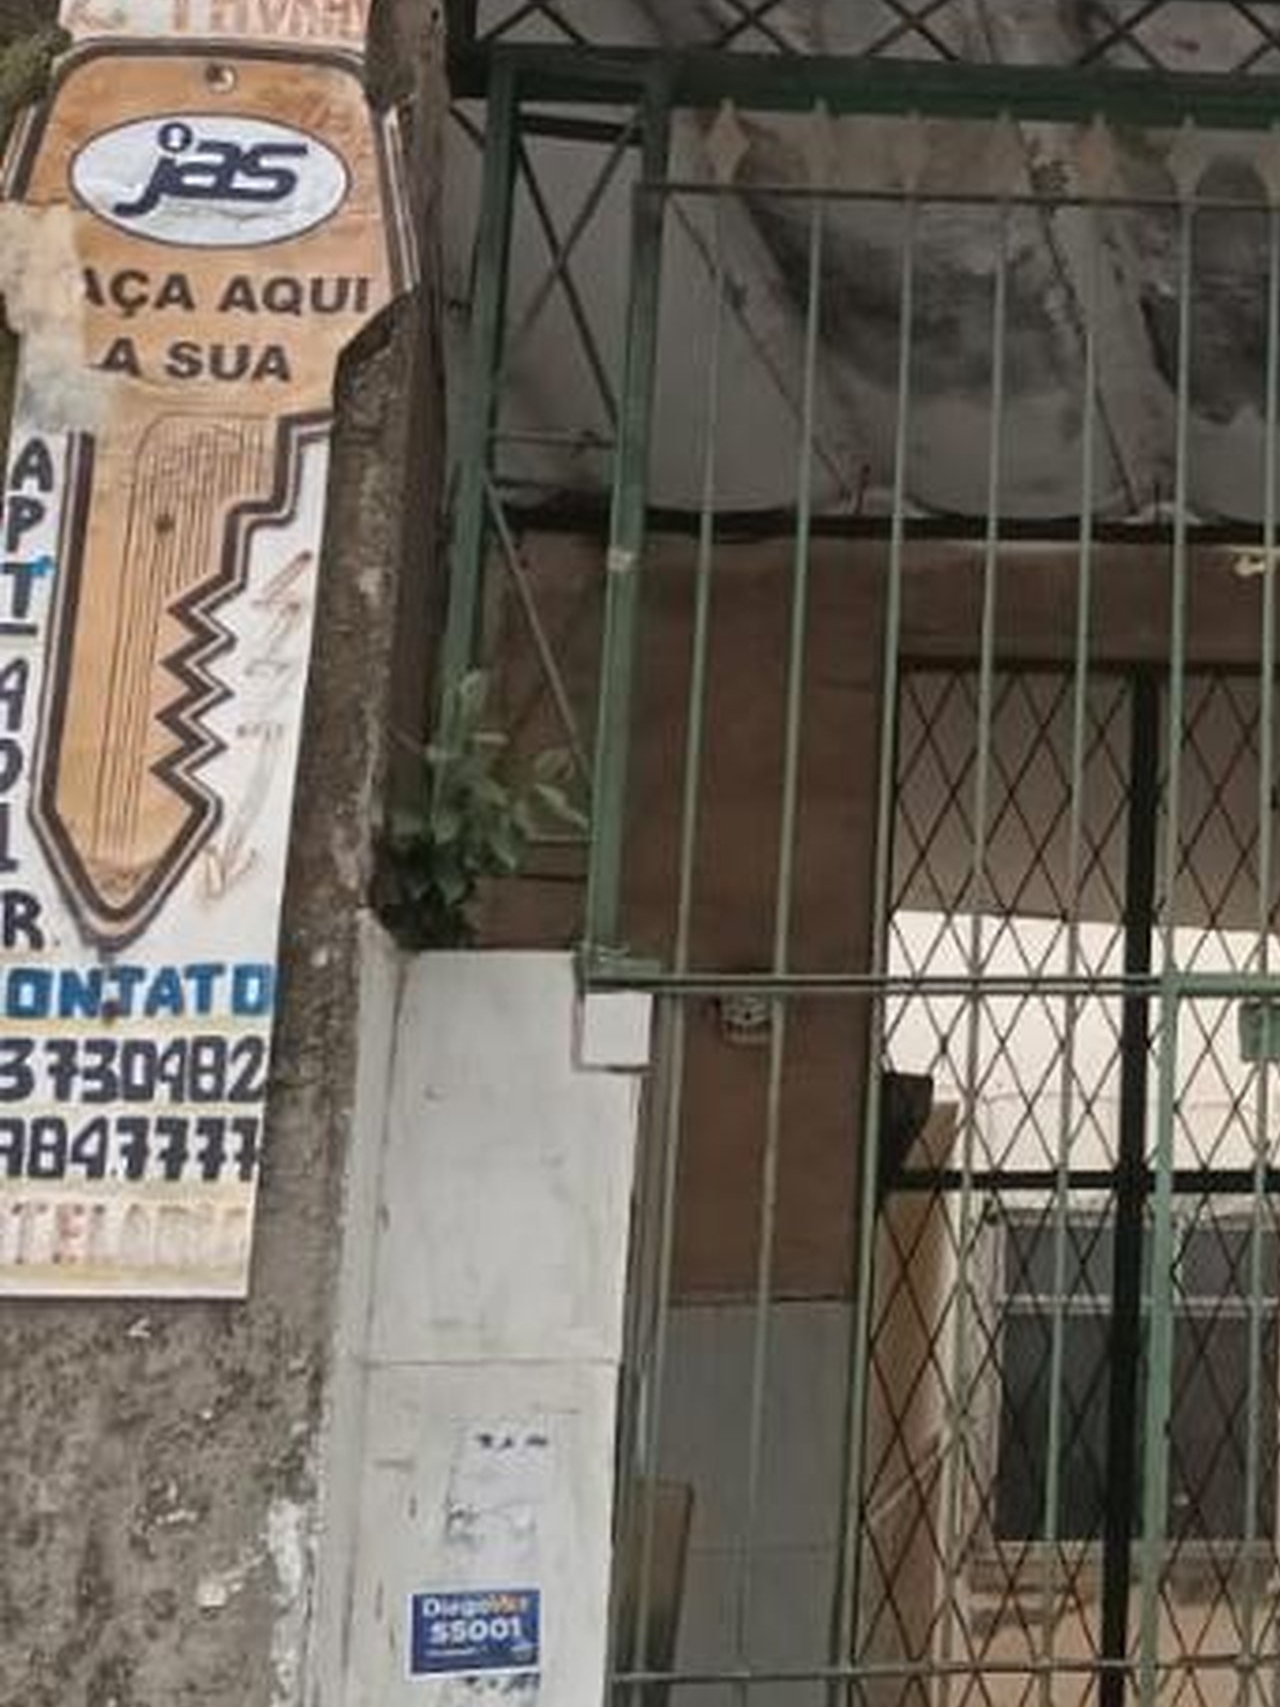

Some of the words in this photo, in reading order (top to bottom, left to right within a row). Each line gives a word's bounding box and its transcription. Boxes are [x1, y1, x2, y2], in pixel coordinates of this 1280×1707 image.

[114, 123, 308, 216] jas
[218, 275, 370, 316] AQUI
[164, 340, 291, 382] SUA
